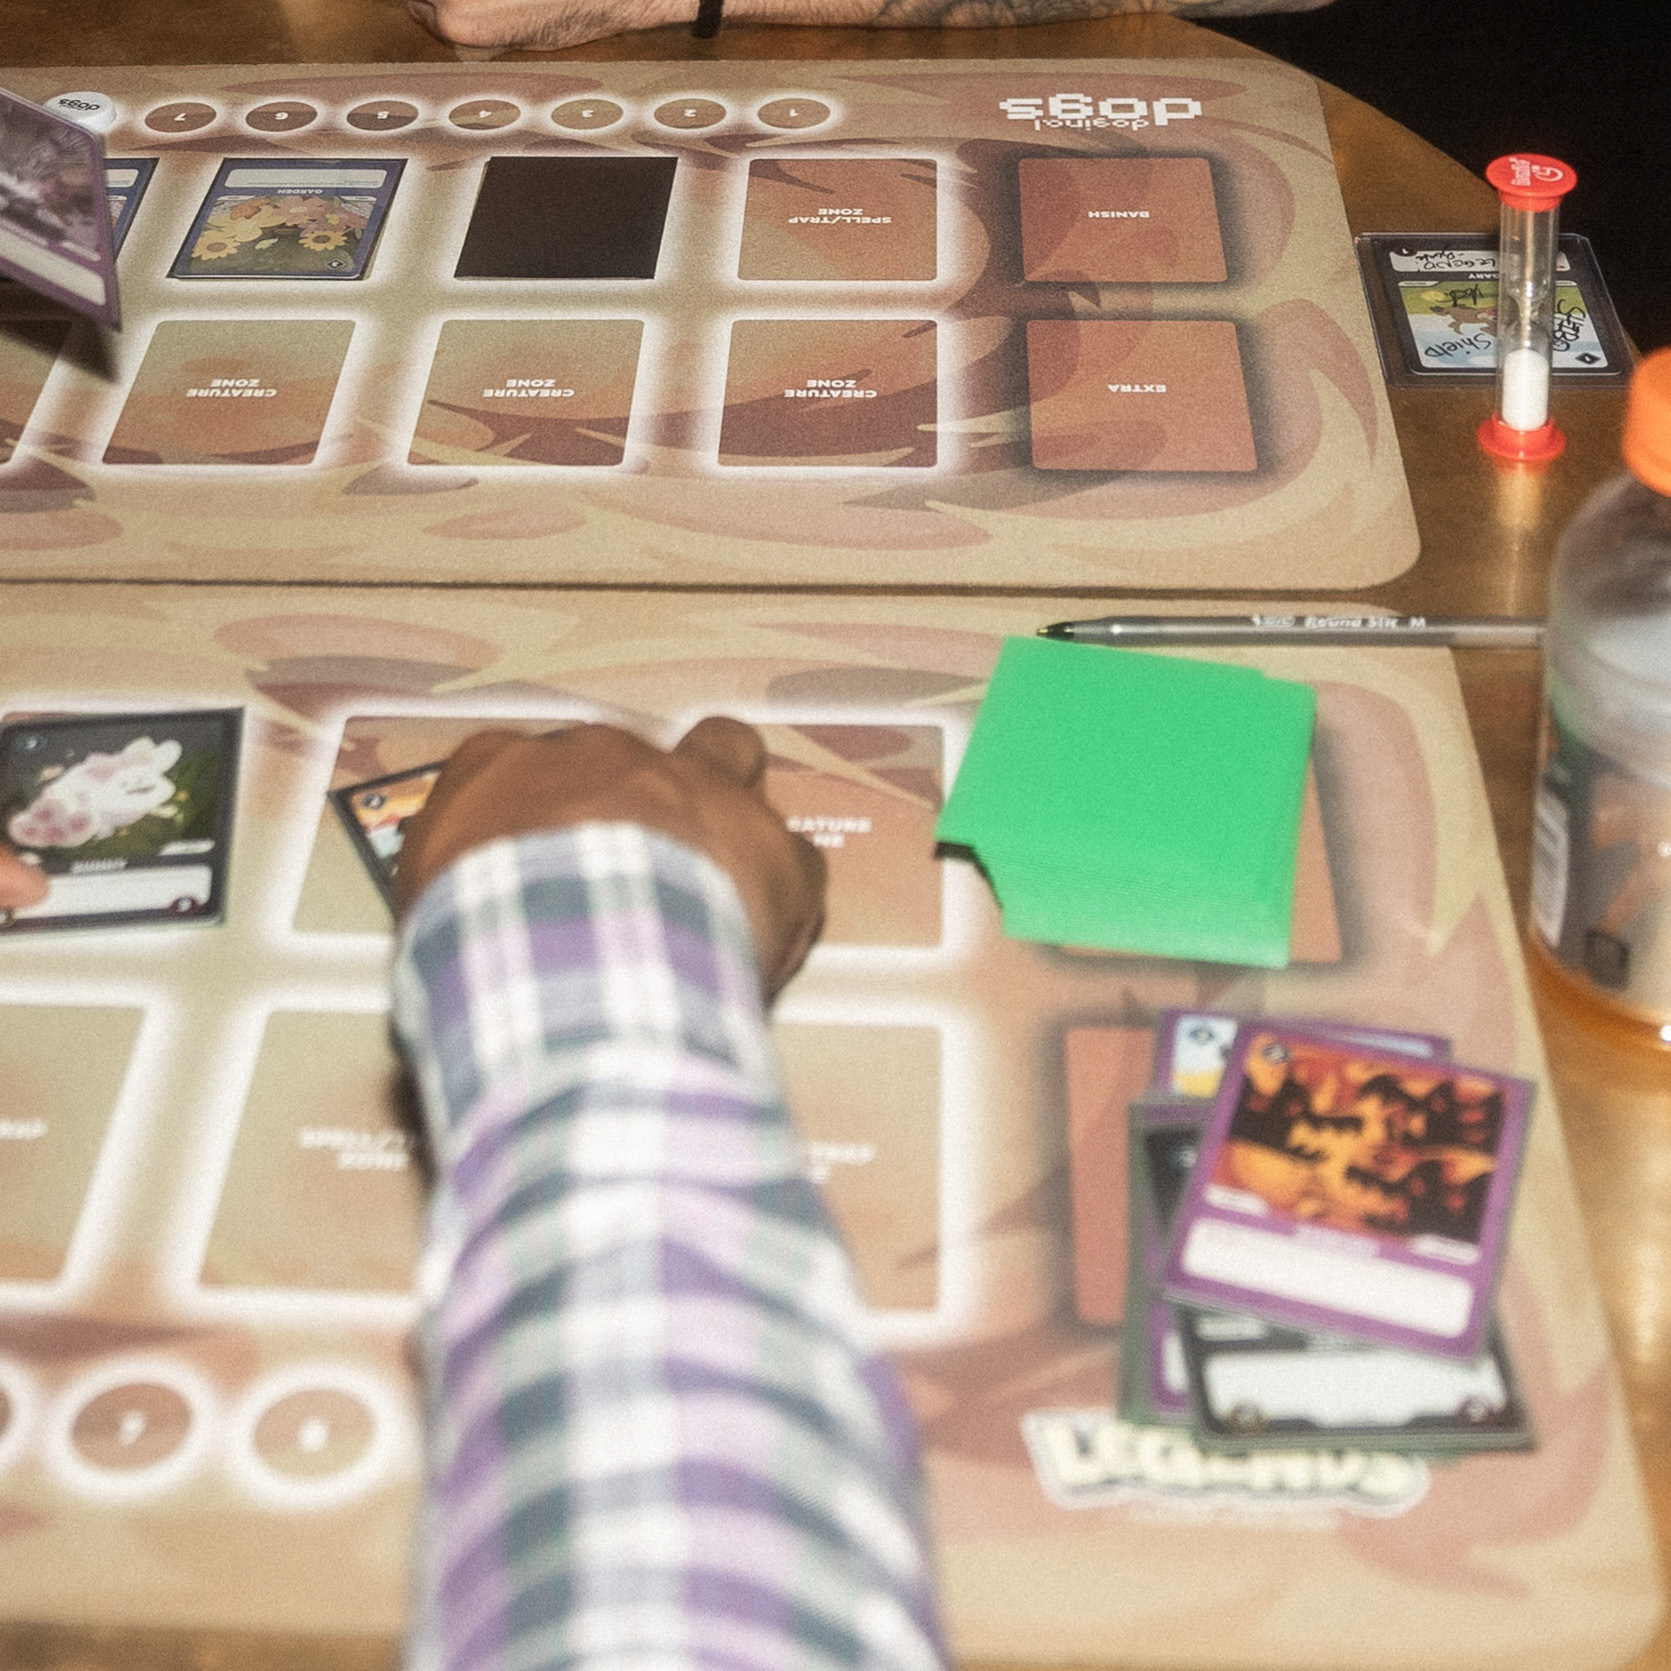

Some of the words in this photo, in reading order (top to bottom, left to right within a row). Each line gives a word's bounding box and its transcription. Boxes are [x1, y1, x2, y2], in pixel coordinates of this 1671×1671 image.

[58, 98, 101, 112] dogs
[999, 93, 1203, 126] dogs
[817, 207, 864, 216] ZONE
[1088, 210, 1151, 219] BANISH
[787, 216, 892, 225] SPELL/TRAP
[210, 378, 261, 387] ZONE
[505, 378, 557, 388] ZONE
[806, 379, 857, 388] ZONE
[185, 388, 278, 398] CREATURE
[482, 389, 575, 399] CREATURE
[783, 389, 878, 399] CREATURE
[1106, 384, 1168, 394] EXTRA
